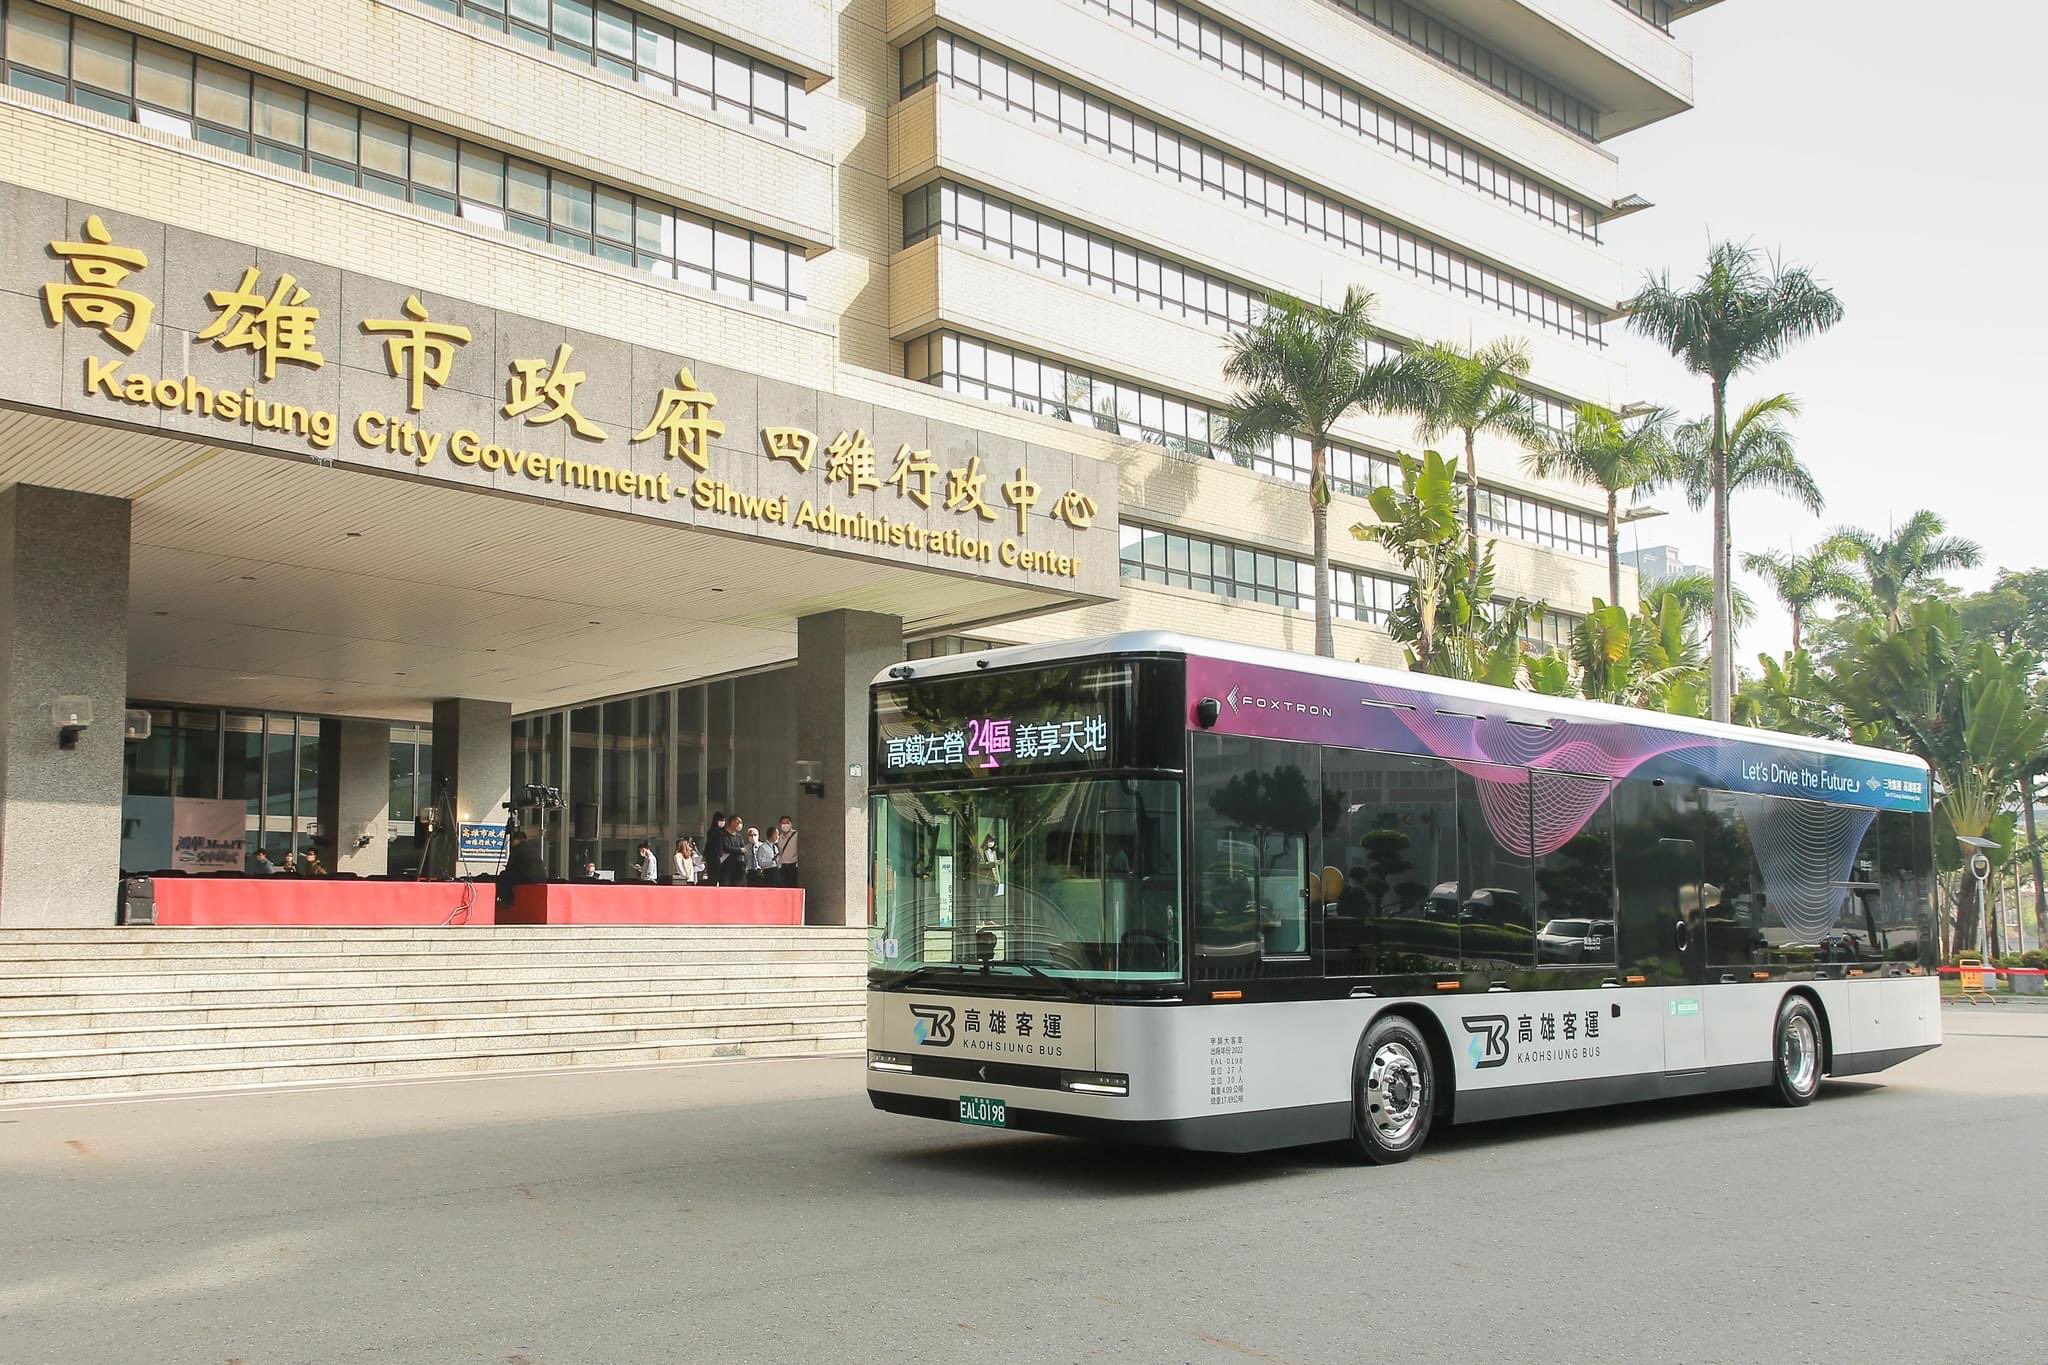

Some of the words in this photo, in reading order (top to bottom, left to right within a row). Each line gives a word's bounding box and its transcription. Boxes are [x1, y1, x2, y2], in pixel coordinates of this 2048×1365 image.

[43, 214, 726, 470] 高雄市政府
[763, 426, 1098, 534] 四維行政中心
[87, 356, 337, 447] Kaohsiung
[357, 411, 441, 464] City
[451, 430, 671, 502] Government
[694, 477, 788, 523] Sihwei
[796, 500, 993, 561] Administration
[1001, 539, 1080, 577] Center
[1242, 696, 1332, 717] FOXTRON
[886, 730, 965, 769] 高鐵左營
[968, 719, 1012, 756] 24區
[1015, 714, 1107, 759] 義享天地
[1742, 760, 1768, 782] Let's
[1771, 764, 1798, 786] Drive
[1800, 768, 1818, 788] the
[1821, 771, 1856, 792] Future
[964, 1008, 1062, 1039] 高雄客運
[1517, 1010, 1600, 1044] 高雄客運
[963, 1039, 1033, 1054] KAOHSIUNG
[1039, 1046, 1062, 1057] BUS
[1517, 1048, 1578, 1064] KAOHSIUNG
[1582, 1046, 1601, 1058] BUS
[960, 1101, 1005, 1122] EAL-0198
